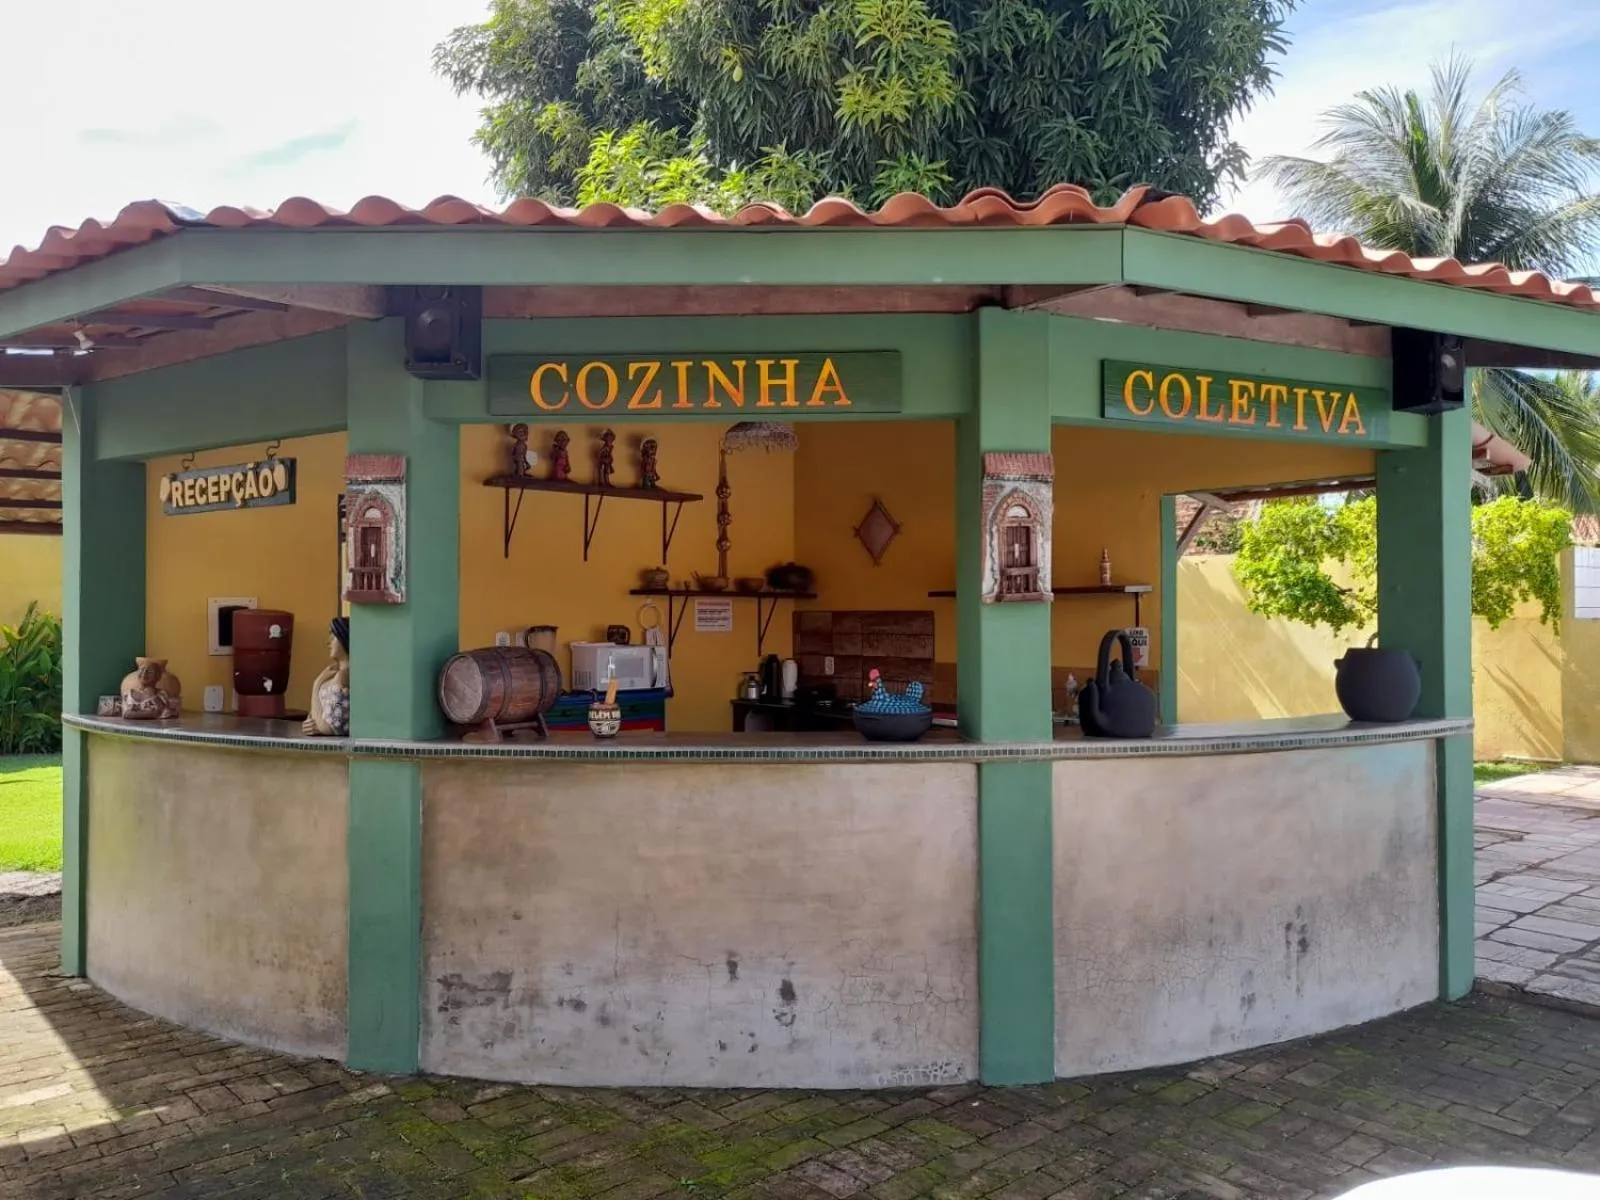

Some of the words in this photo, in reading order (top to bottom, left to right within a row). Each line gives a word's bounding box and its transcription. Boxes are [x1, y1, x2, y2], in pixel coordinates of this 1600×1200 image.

[530, 358, 852, 410] COZINHA
[1123, 369, 1366, 435] COLETIVA
[171, 463, 273, 508] RECEPÇÃO
